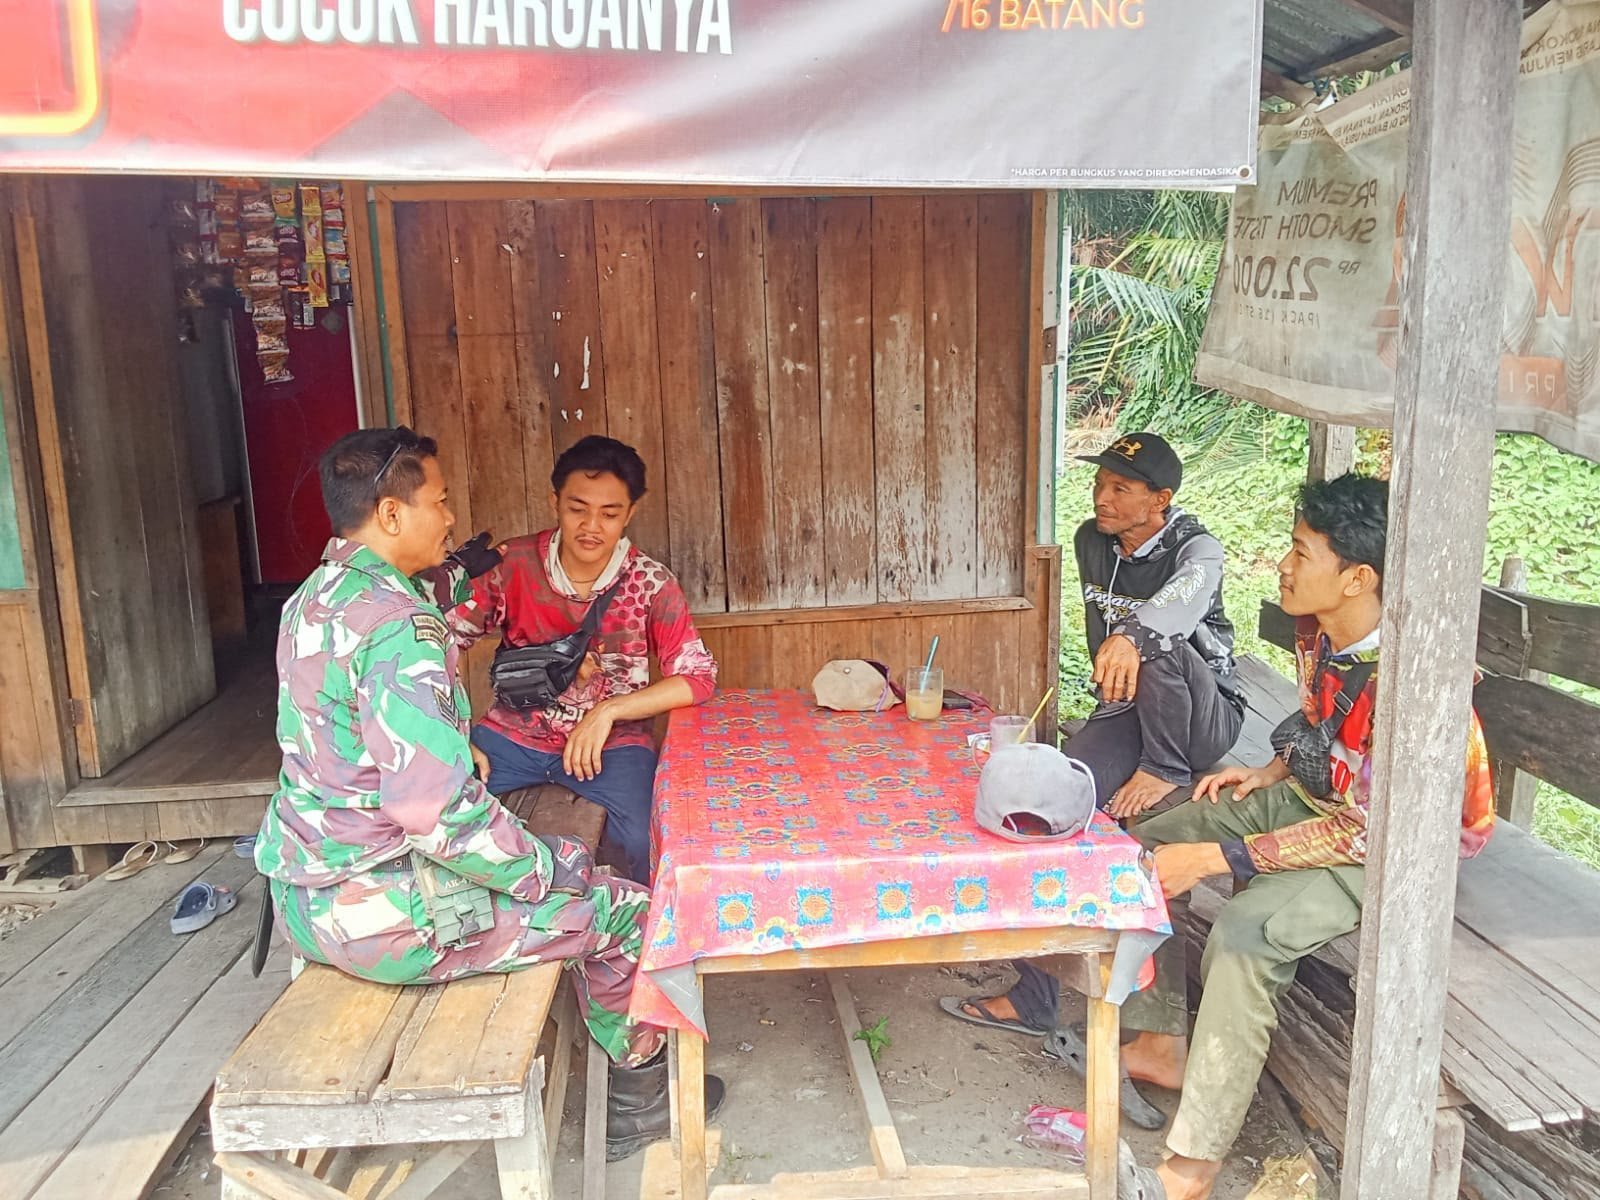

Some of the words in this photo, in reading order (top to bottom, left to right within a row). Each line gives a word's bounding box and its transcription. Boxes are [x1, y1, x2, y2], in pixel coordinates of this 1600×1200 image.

[999, 0, 1145, 30] BATANG
[1049, 168, 1068, 177] PER
[1070, 168, 1116, 178] BUNGKUS
[1118, 168, 1144, 177] YANG
[1145, 167, 1239, 177] DIREKOMENDASIKA
